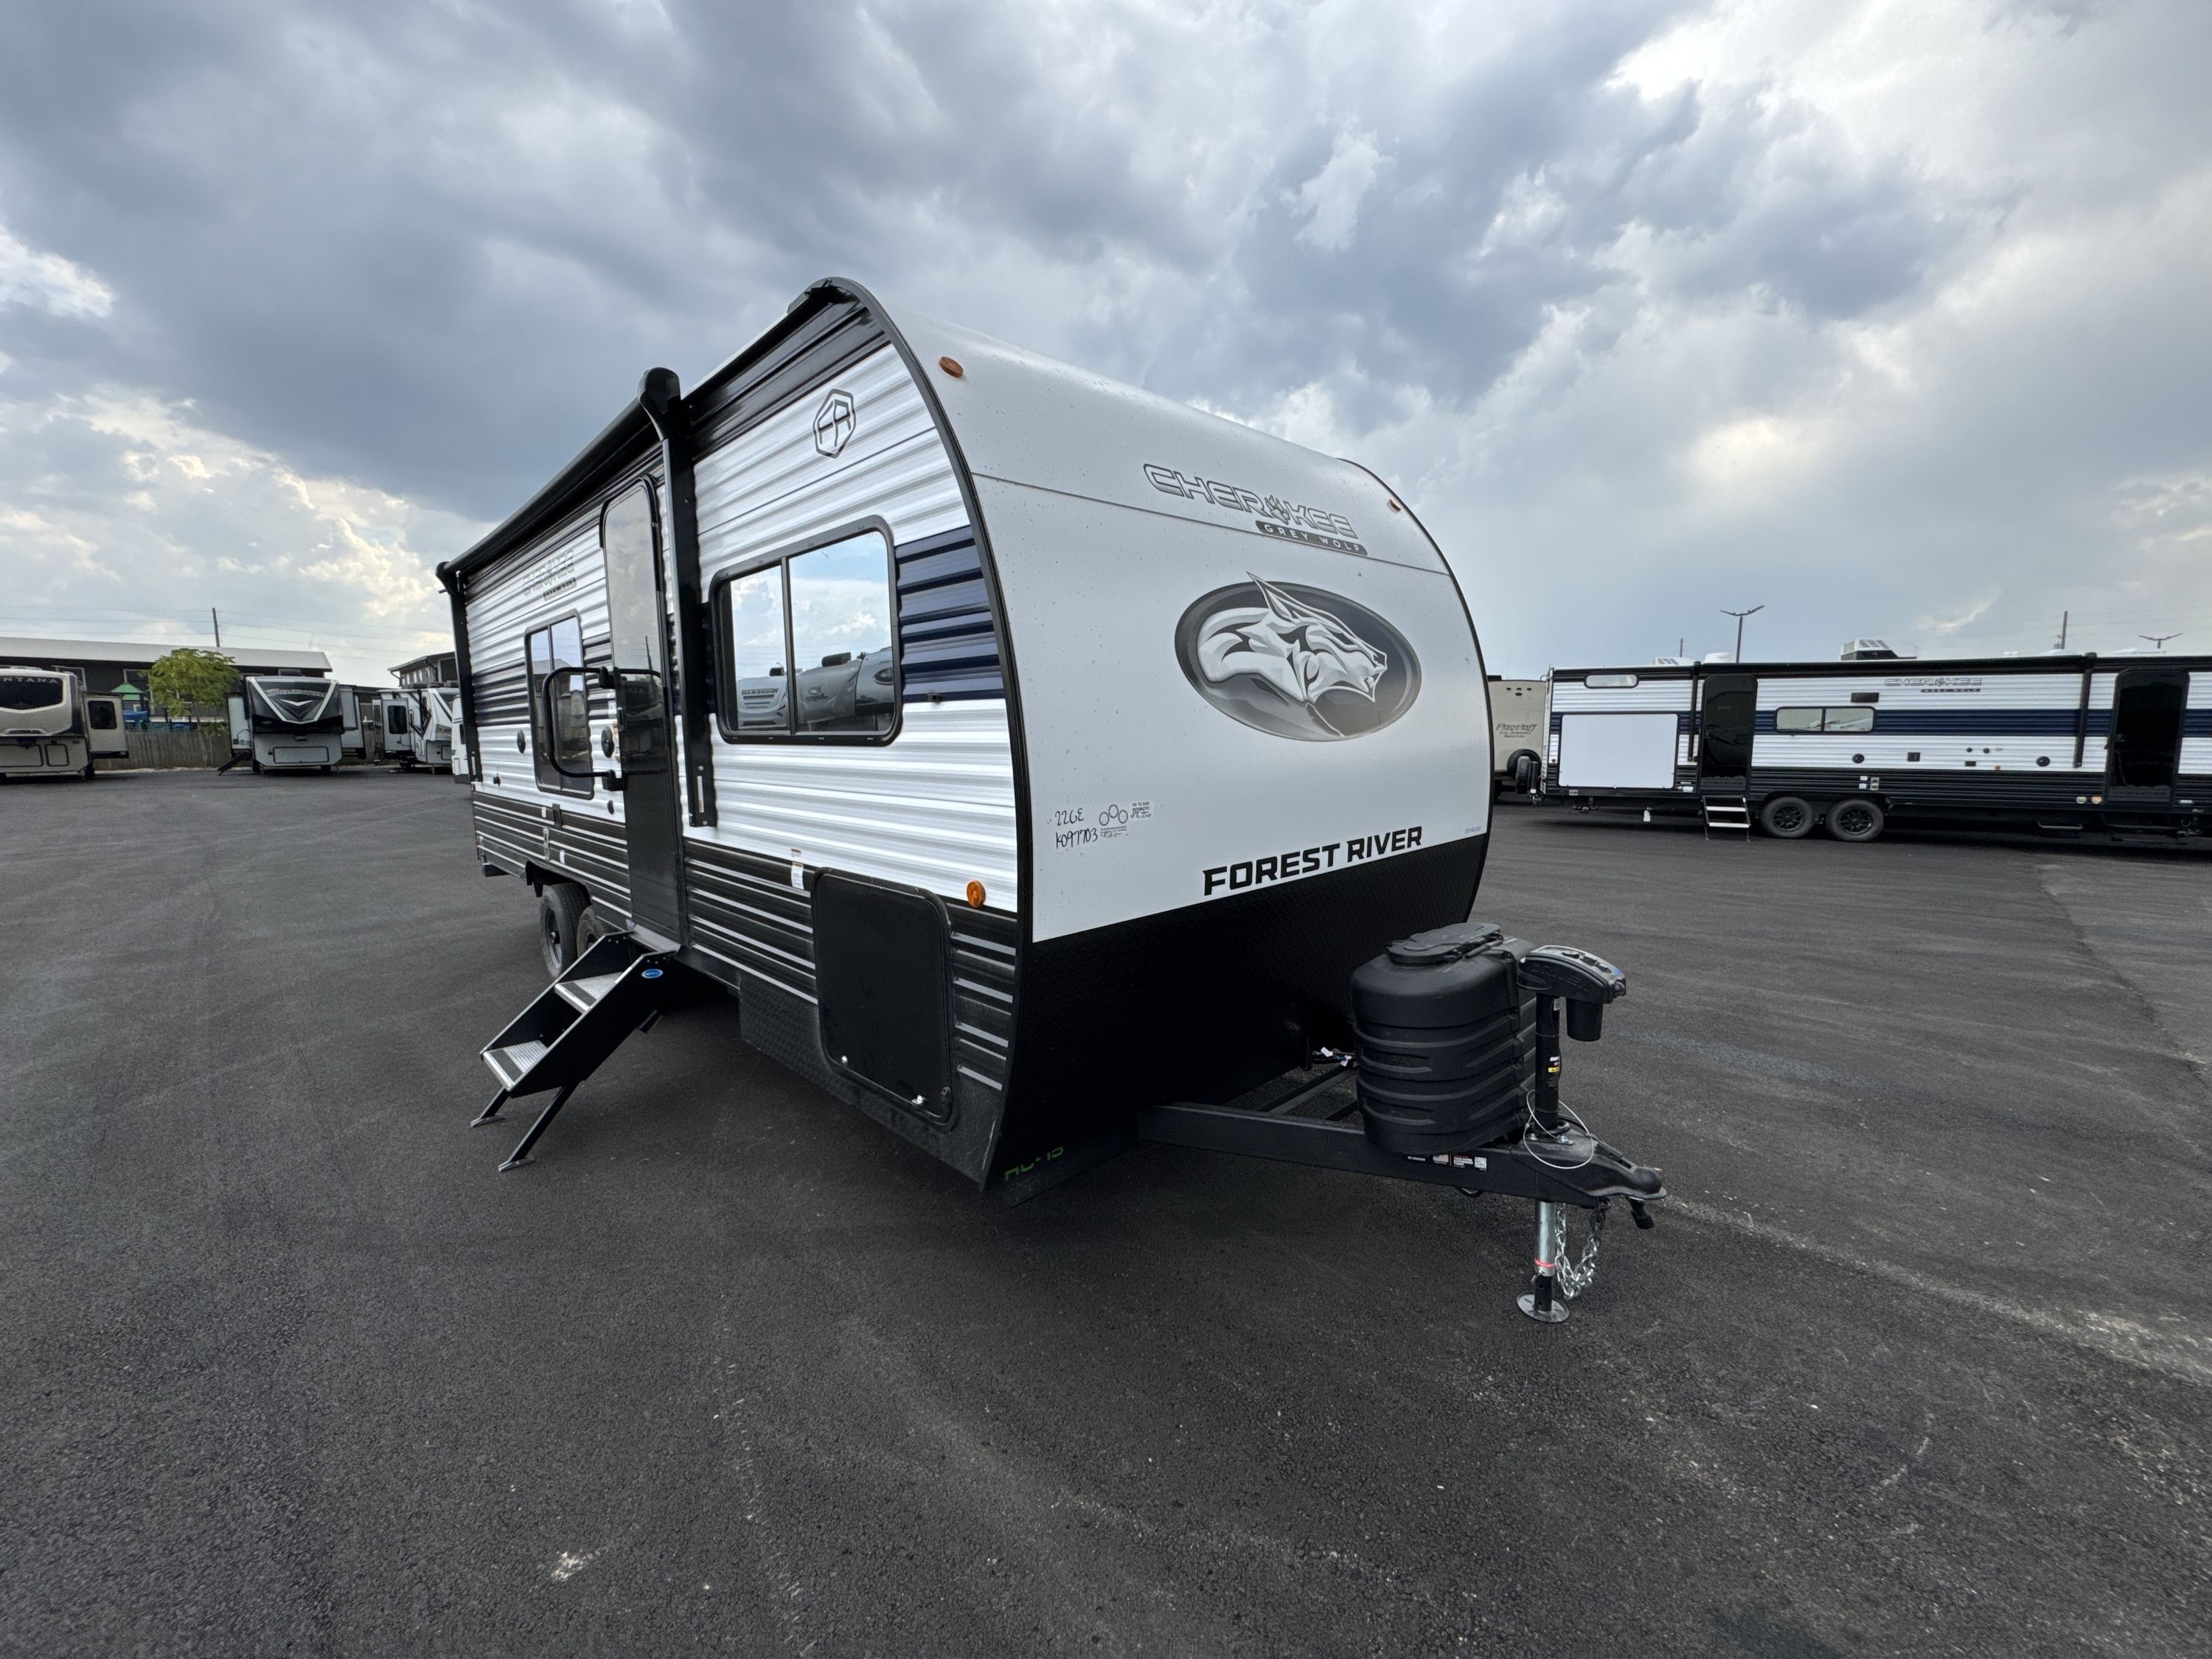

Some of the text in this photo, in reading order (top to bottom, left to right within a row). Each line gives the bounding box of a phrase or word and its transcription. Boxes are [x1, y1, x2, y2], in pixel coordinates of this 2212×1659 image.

[1264, 524, 1360, 552] GREY WOLF
[1203, 825, 1422, 897] FOREST RIVER
